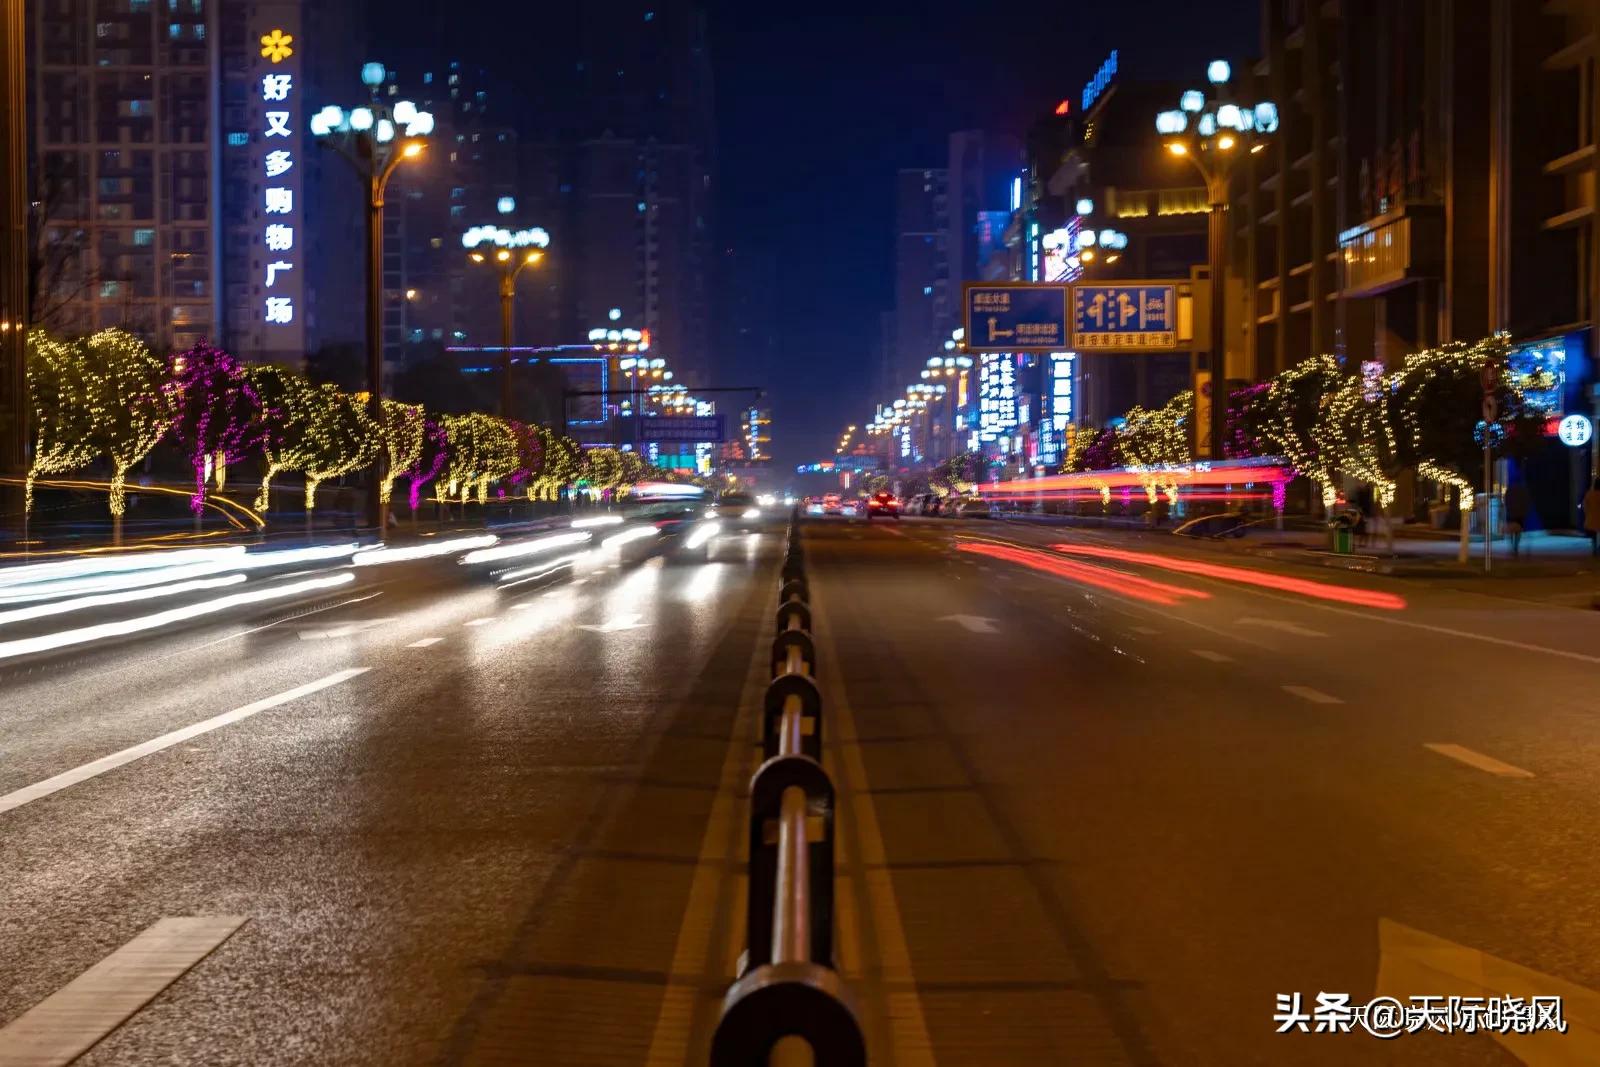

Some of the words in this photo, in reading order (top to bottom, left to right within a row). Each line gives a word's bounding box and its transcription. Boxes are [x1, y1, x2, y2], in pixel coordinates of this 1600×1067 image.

[262, 74, 293, 324] 好又多购物广场
